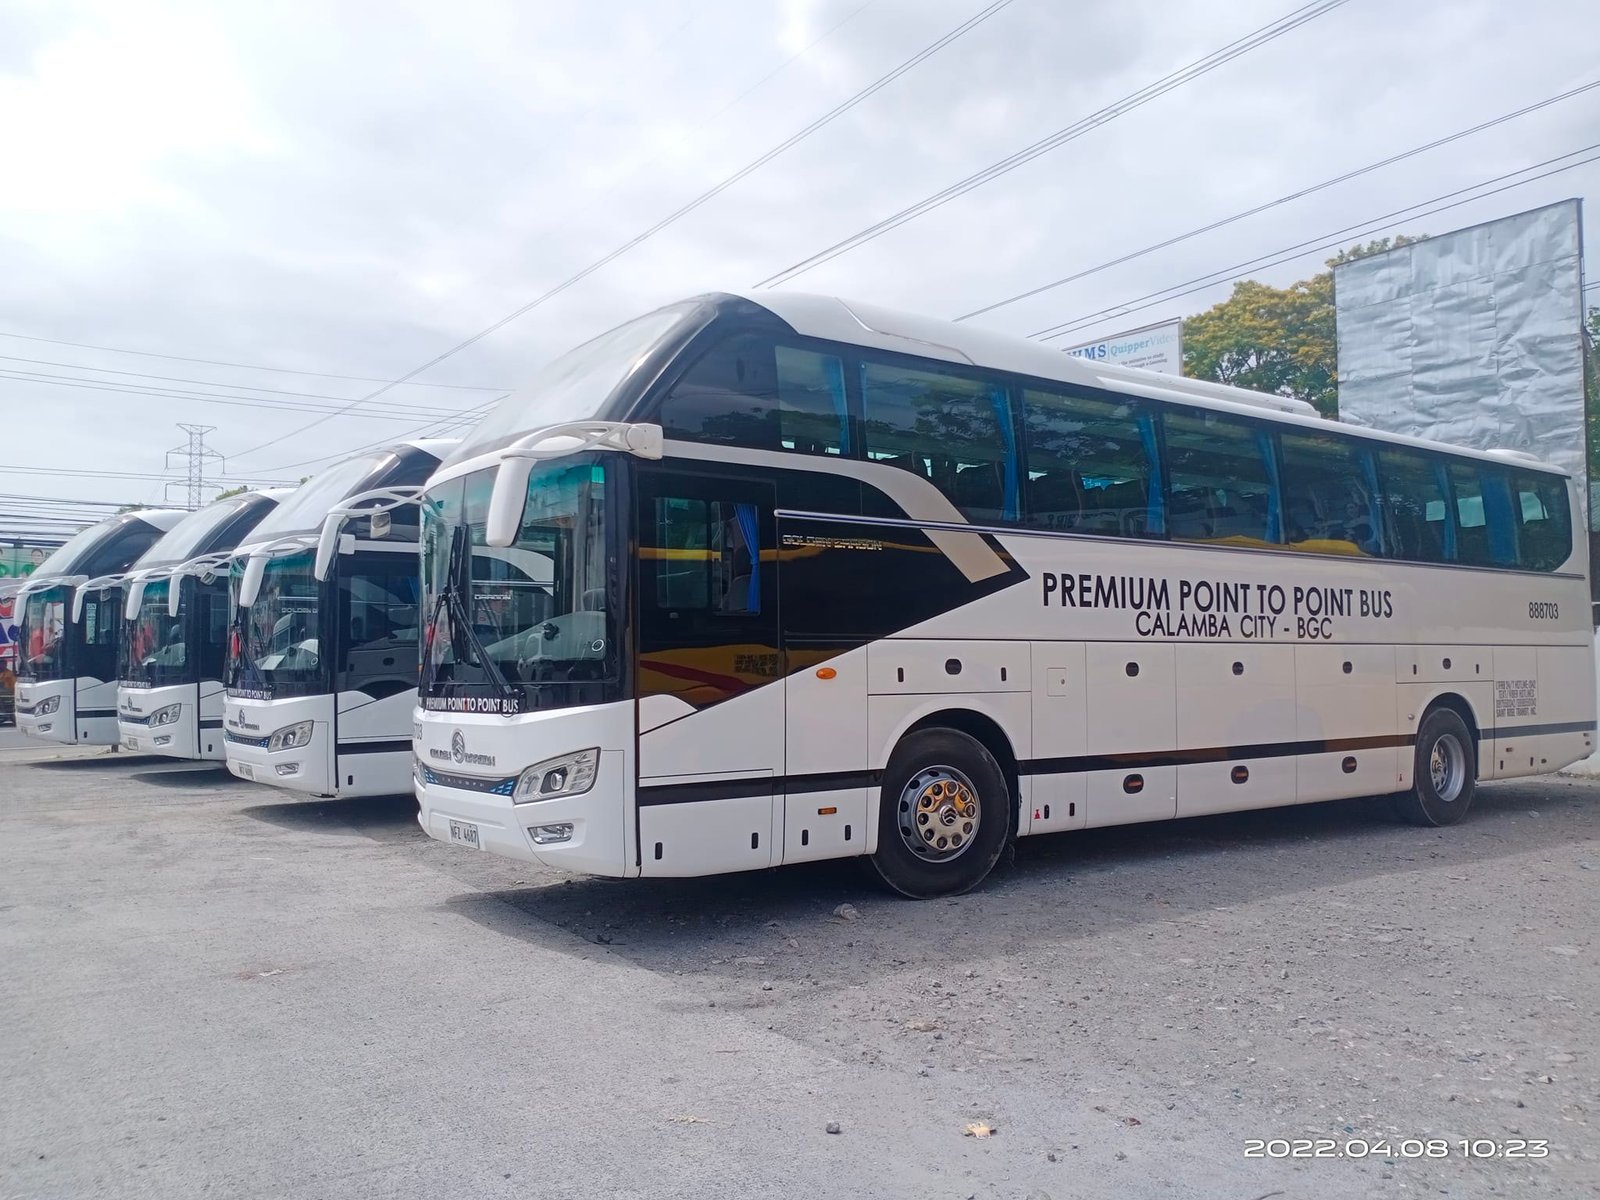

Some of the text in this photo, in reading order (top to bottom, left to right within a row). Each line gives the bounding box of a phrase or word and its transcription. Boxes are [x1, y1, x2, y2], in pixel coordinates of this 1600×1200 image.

[1042, 572, 1393, 619] PREMIUM POINT TO POINT BUS
[1528, 601, 1559, 620] 888703
[1135, 611, 1232, 637] CALAMBA
[1240, 614, 1277, 639] CITY
[1297, 616, 1333, 640] BGC
[447, 697, 465, 711] POINT
[467, 697, 476, 711] TO
[478, 698, 501, 712] POINT
[502, 699, 519, 713] BUS
